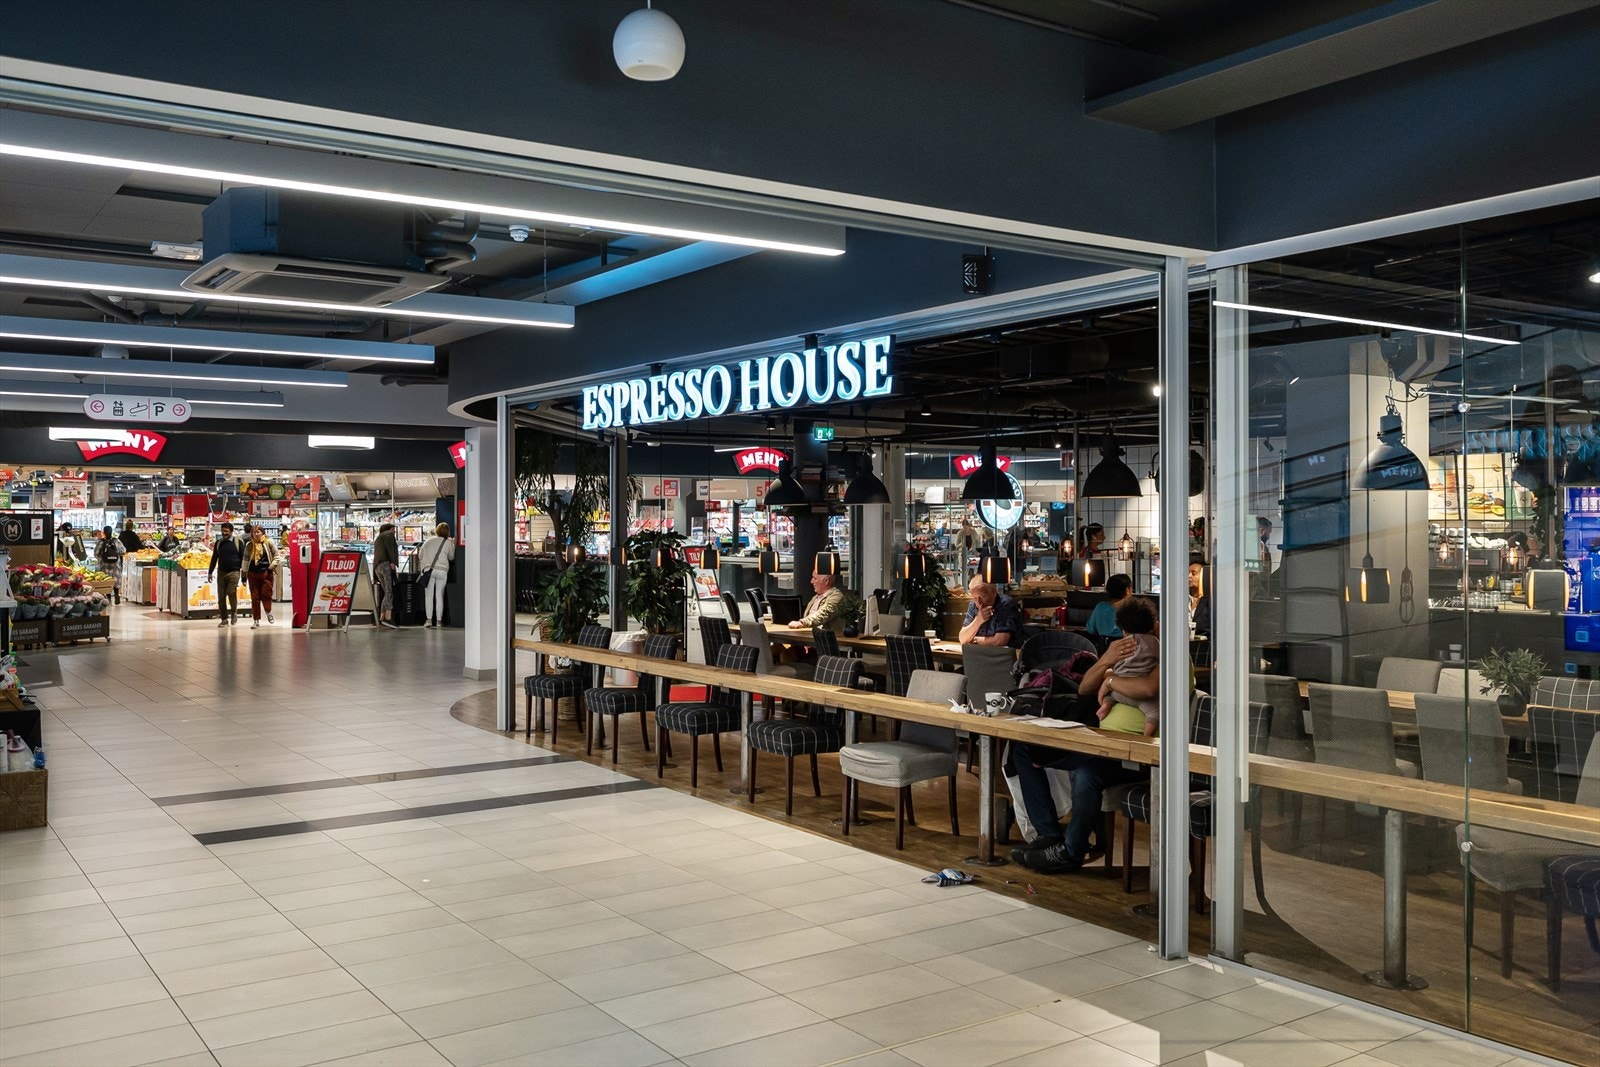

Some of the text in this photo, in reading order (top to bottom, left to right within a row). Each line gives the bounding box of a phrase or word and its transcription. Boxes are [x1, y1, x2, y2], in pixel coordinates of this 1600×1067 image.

[582, 335, 894, 430] ESPRESSO HOUSE
[155, 406, 164, 416] P
[961, 456, 1006, 471] MEY
[756, 486, 763, 497] 5
[326, 559, 355, 570] TILBUD
